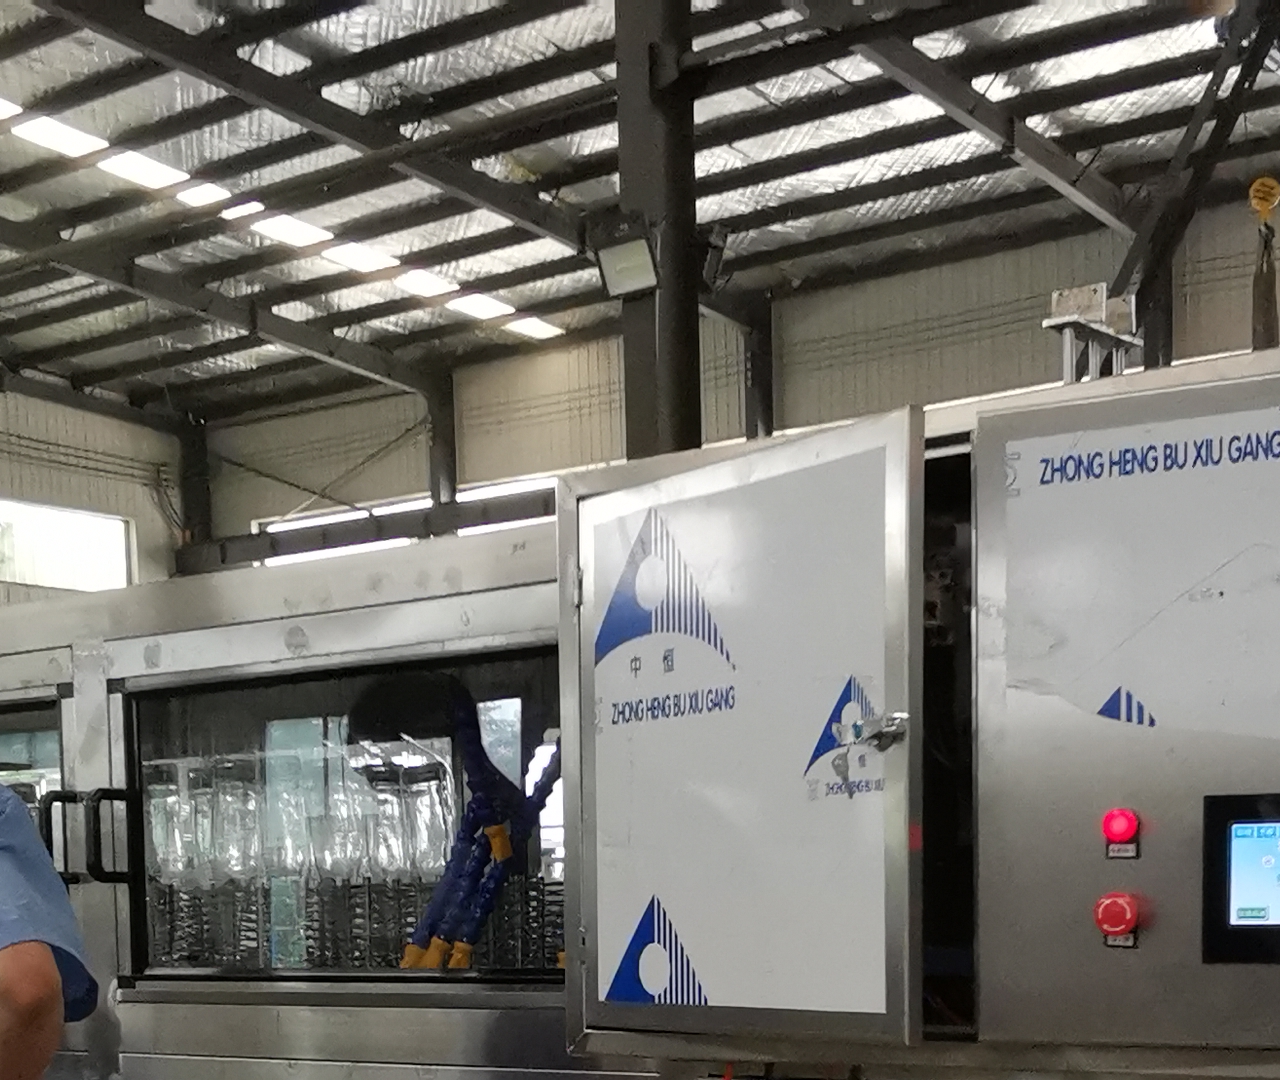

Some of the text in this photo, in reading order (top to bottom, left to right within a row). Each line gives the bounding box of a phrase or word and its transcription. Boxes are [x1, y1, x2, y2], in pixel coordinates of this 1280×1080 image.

[1039, 452, 1104, 485] ZHONG
[1109, 445, 1158, 477] HENG
[1163, 441, 1188, 471] BU
[1192, 436, 1223, 468] XIU
[612, 685, 735, 725] ZHONG HENG BU XIU GANG
